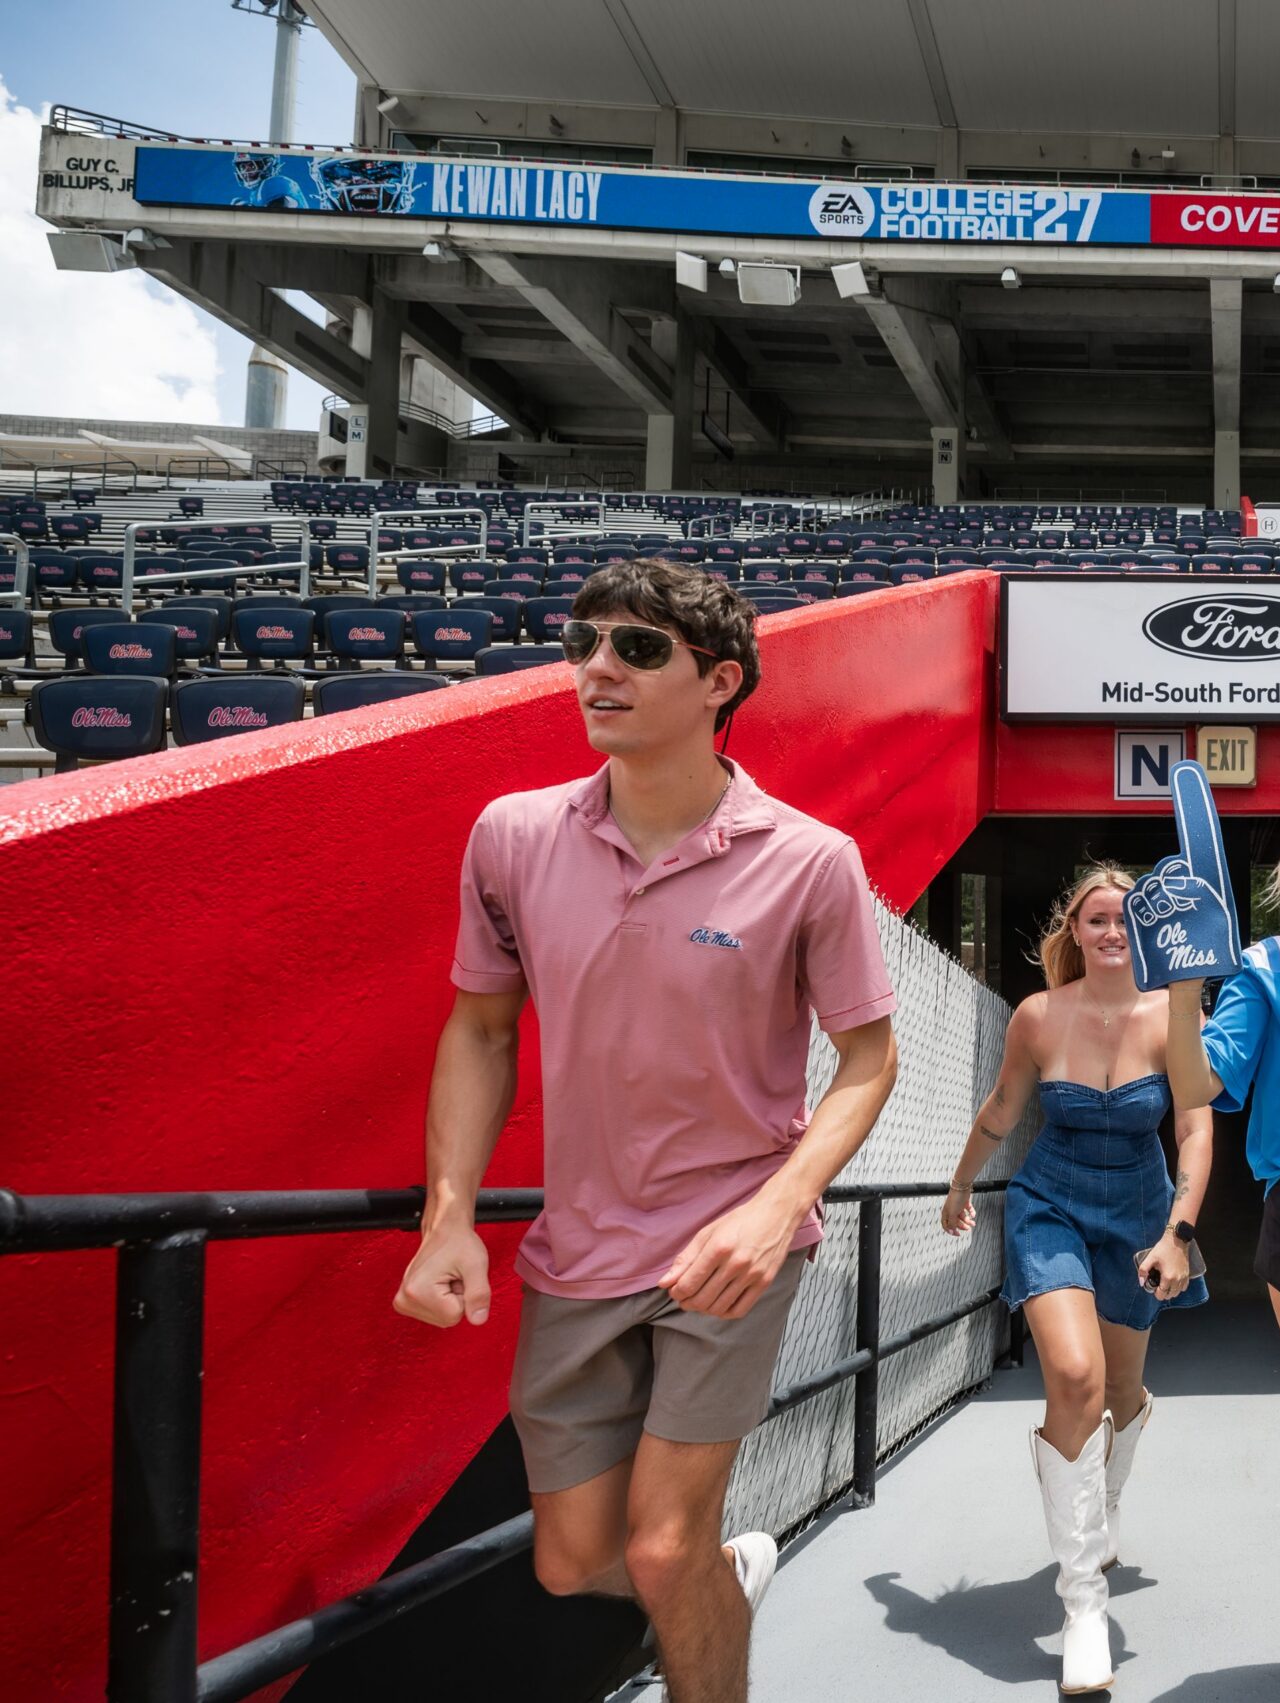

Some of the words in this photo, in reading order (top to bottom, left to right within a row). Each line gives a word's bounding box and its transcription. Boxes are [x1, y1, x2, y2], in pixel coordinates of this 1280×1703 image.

[66, 157, 101, 171] GUY
[104, 159, 119, 173] C.
[43, 174, 113, 193] BILLUPS,
[432, 164, 526, 217] KEWAN
[534, 171, 602, 221] LACY
[821, 193, 863, 213] EA
[880, 187, 1033, 216] COLLEGE
[819, 212, 865, 225] SPORTS
[880, 214, 1033, 240] FOOTBALL
[1032, 191, 1103, 241] 27
[1101, 682, 1222, 704] Mid-South
[1229, 682, 1280, 704] Ford
[72, 707, 96, 727] Ole
[94, 707, 131, 727] Miss
[208, 707, 231, 726] Ole
[230, 707, 268, 727] Miss
[1131, 745, 1169, 786] N
[1206, 739, 1249, 772] EXIT
[1157, 921, 1187, 949] Ole
[1167, 946, 1219, 971] Miss
